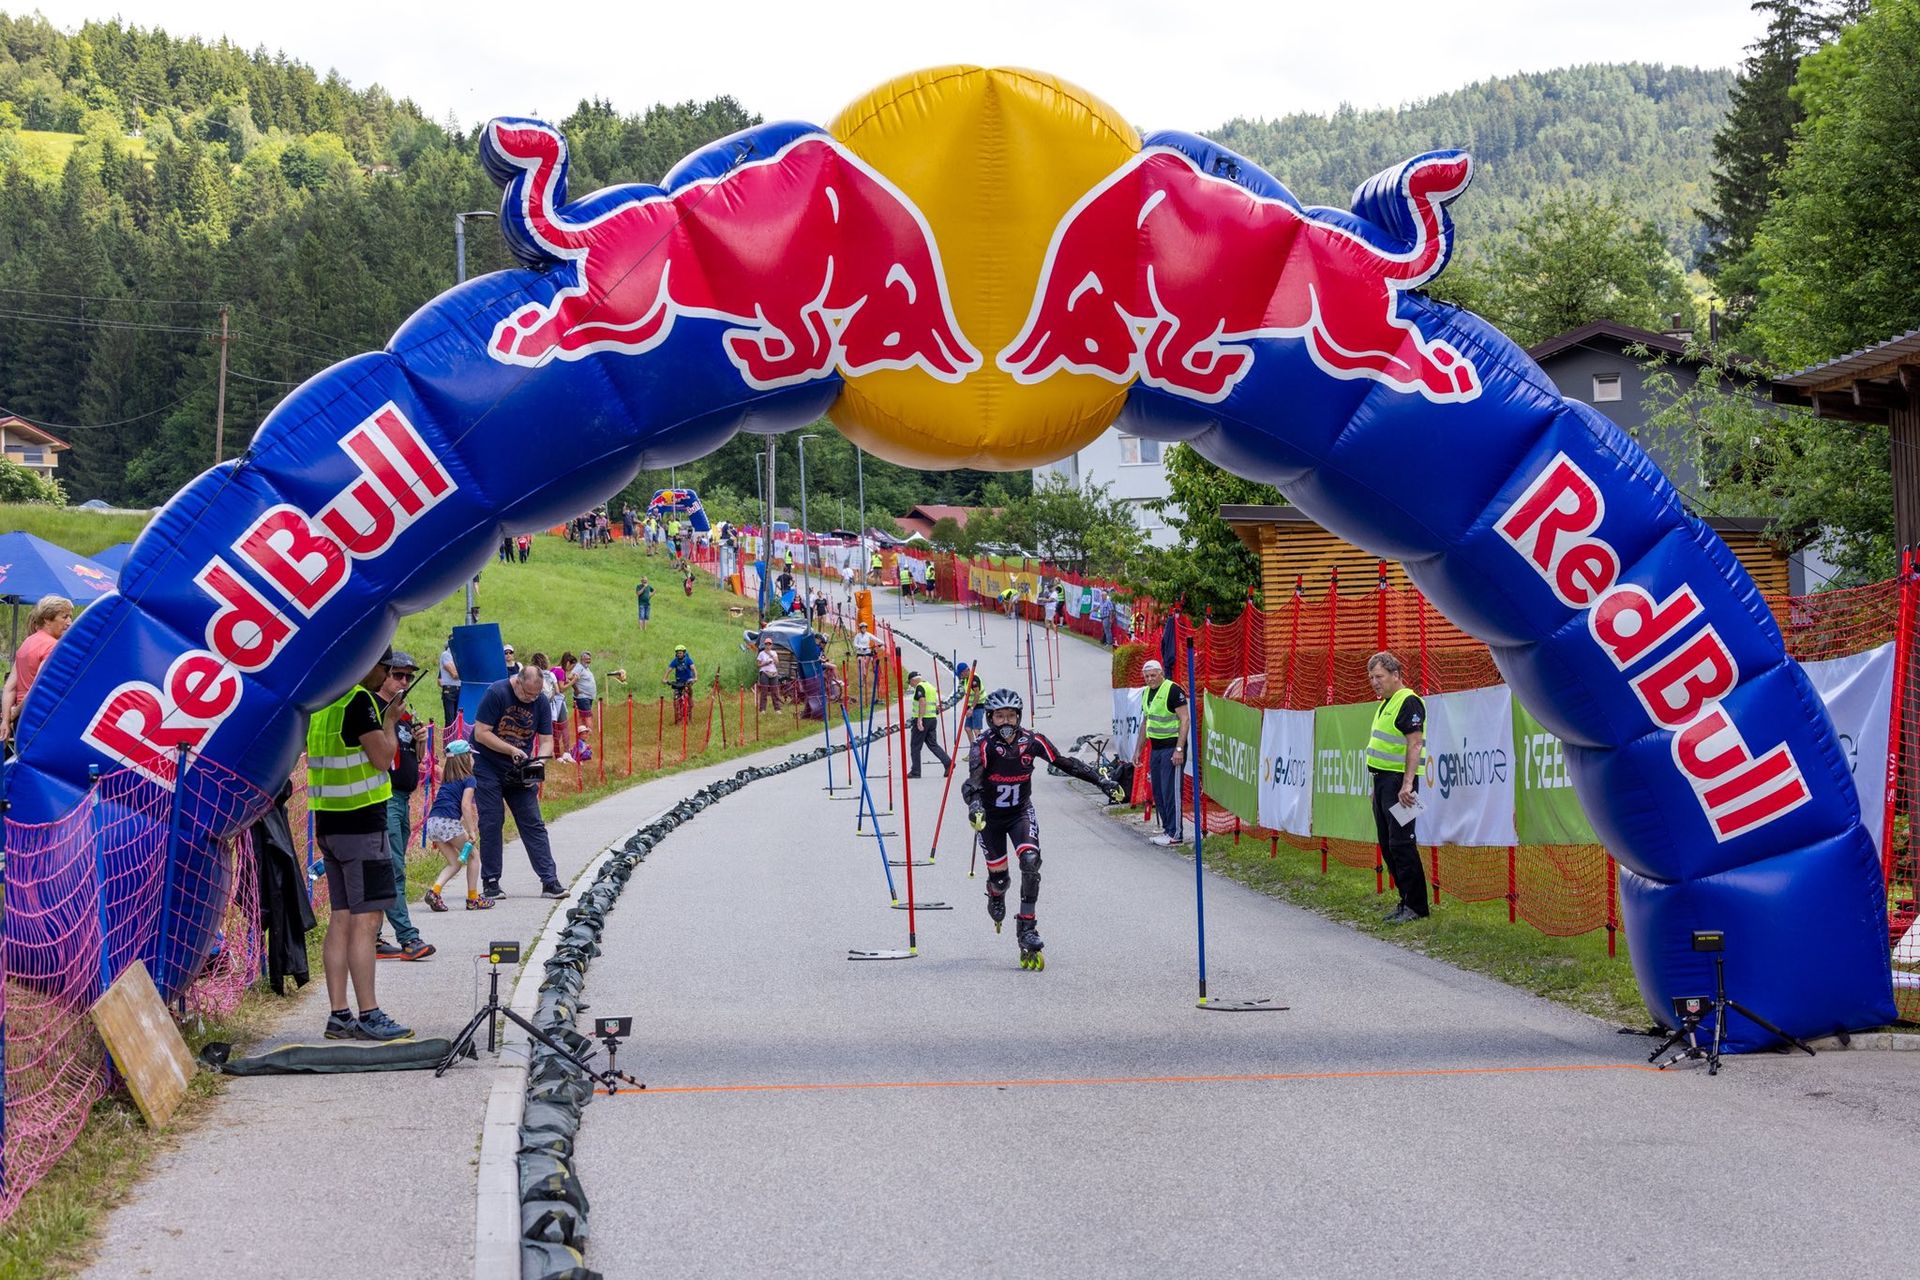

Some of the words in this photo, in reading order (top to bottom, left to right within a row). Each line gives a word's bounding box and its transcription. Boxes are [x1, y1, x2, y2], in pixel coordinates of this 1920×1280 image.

[1493, 451, 1703, 671] Red
[1628, 624, 1811, 842] Bull
[1322, 749, 1346, 794] FEEL
[995, 784, 1020, 807] 21
